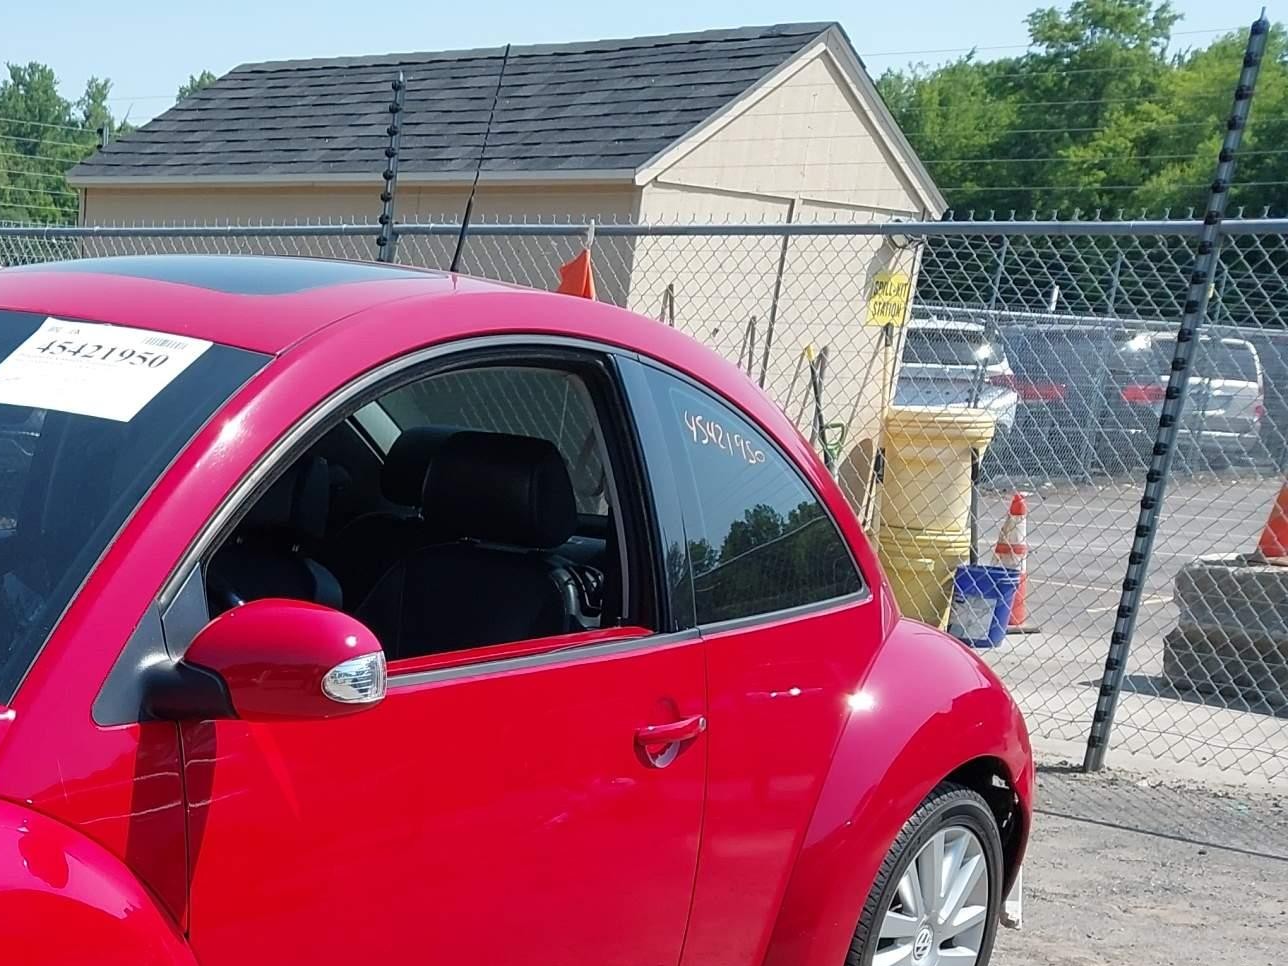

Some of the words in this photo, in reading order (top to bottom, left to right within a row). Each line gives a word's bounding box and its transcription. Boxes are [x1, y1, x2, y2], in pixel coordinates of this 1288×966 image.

[872, 301, 902, 317] STATION
[35, 339, 170, 369] 45421950
[684, 410, 765, 464] 45421950
